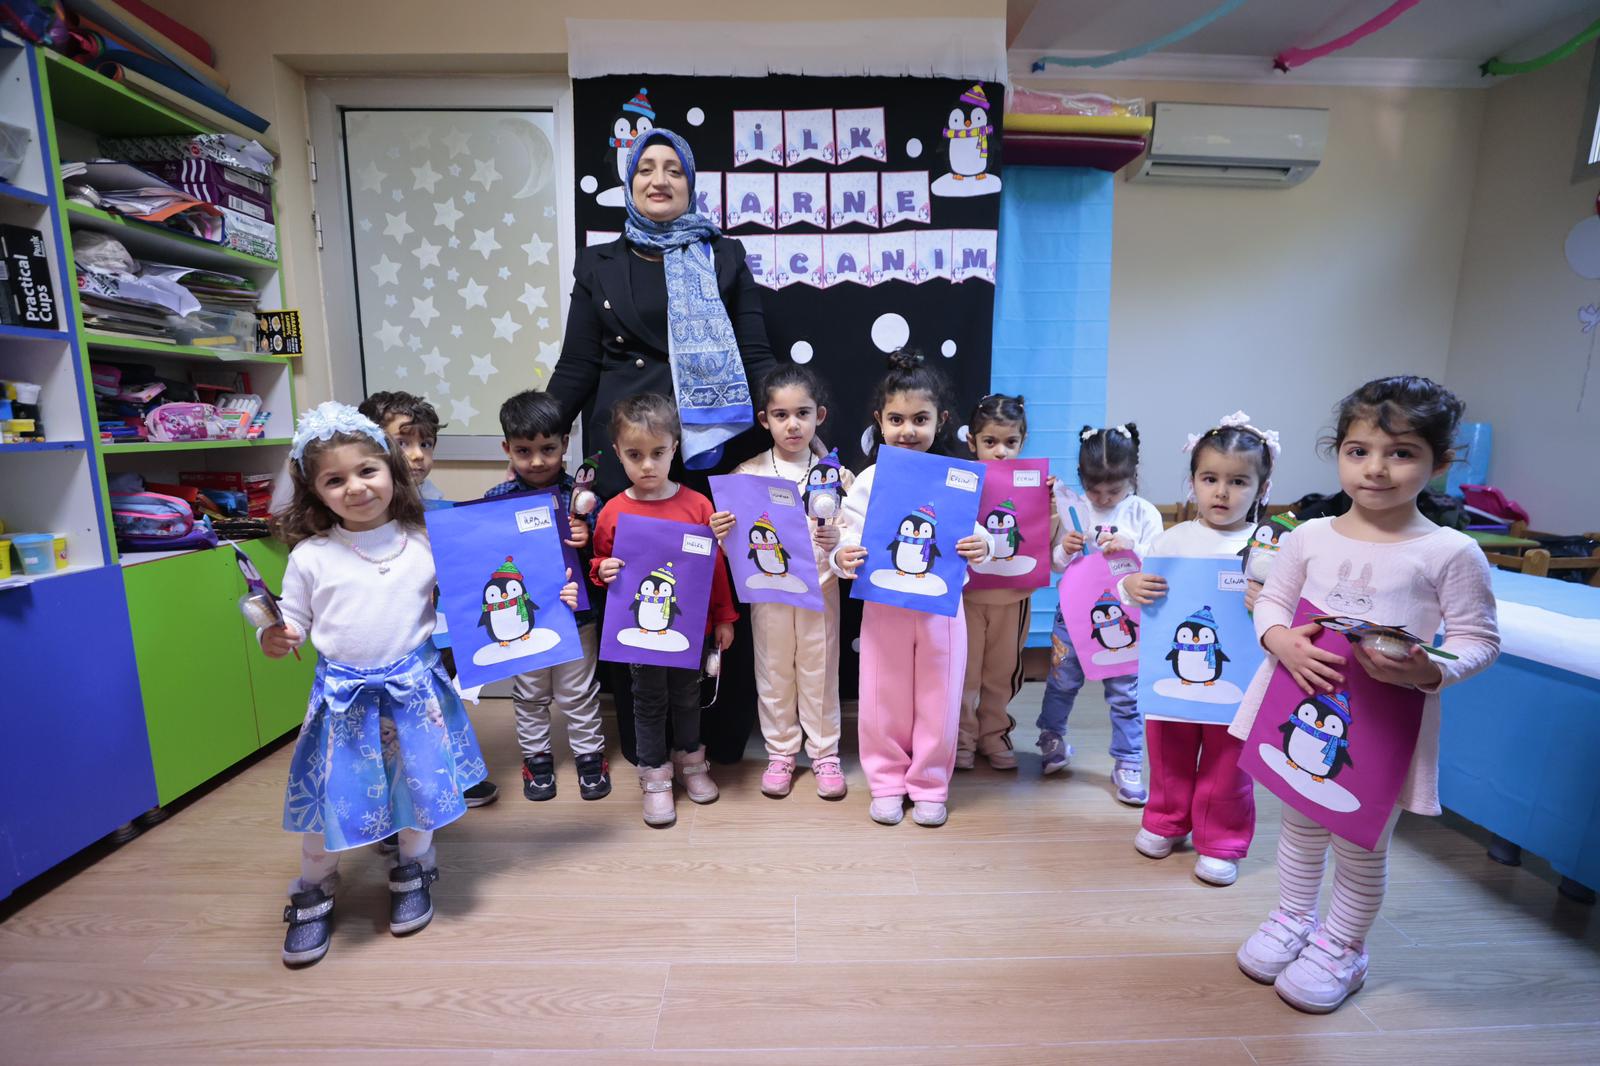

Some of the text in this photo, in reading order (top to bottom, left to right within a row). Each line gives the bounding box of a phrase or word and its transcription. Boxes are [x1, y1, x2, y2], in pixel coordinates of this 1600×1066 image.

[753, 123, 873, 150] İLK
[696, 190, 916, 214] KARNE
[745, 248, 988, 275] ECANIM
[13, 254, 40, 321] Practical
[37, 284, 53, 322] Cups
